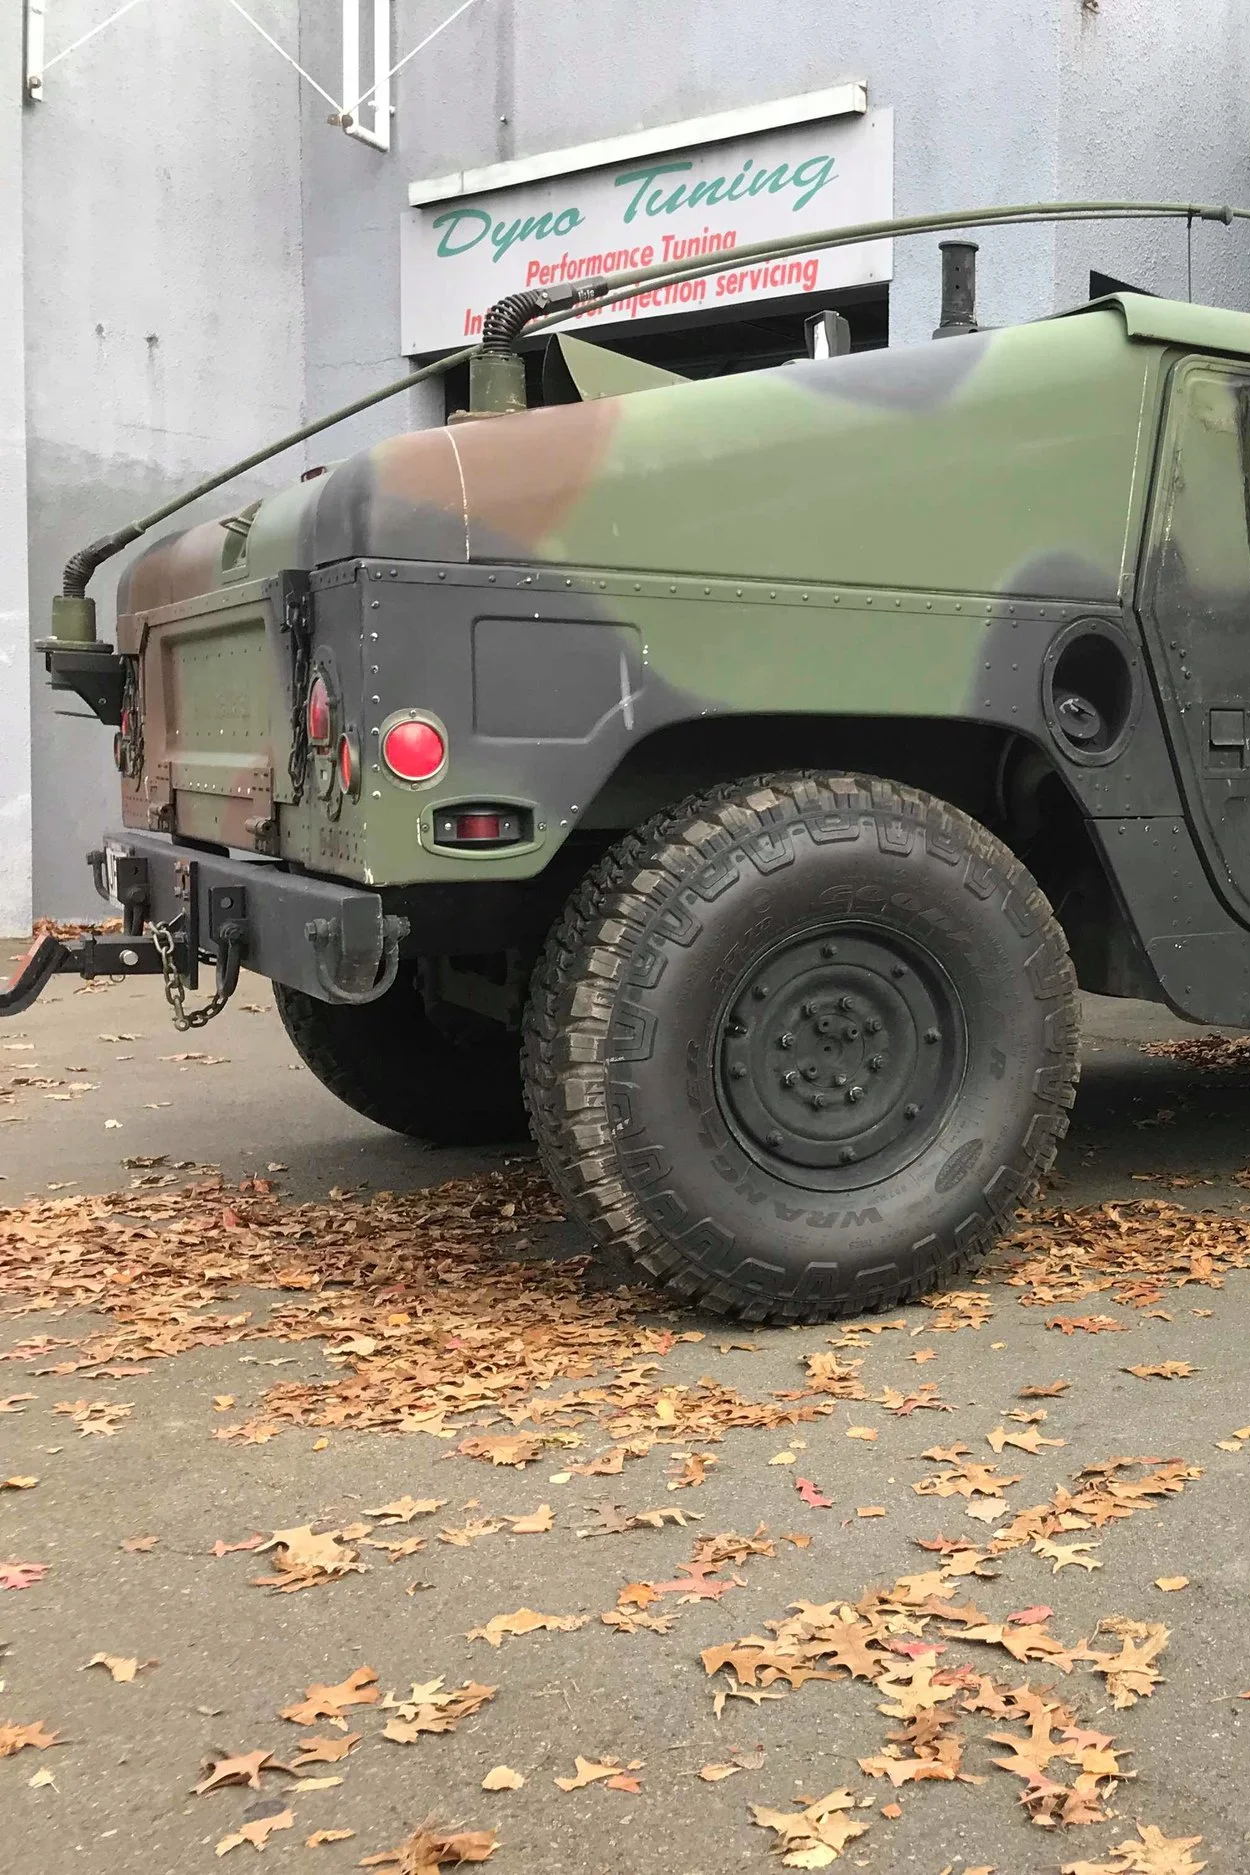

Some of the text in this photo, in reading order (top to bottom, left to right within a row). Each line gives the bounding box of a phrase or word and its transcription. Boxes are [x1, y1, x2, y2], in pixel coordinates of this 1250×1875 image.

[432, 153, 839, 263] Dyno Tuning
[525, 244, 654, 287] Performance
[716, 258, 819, 297] servicing
